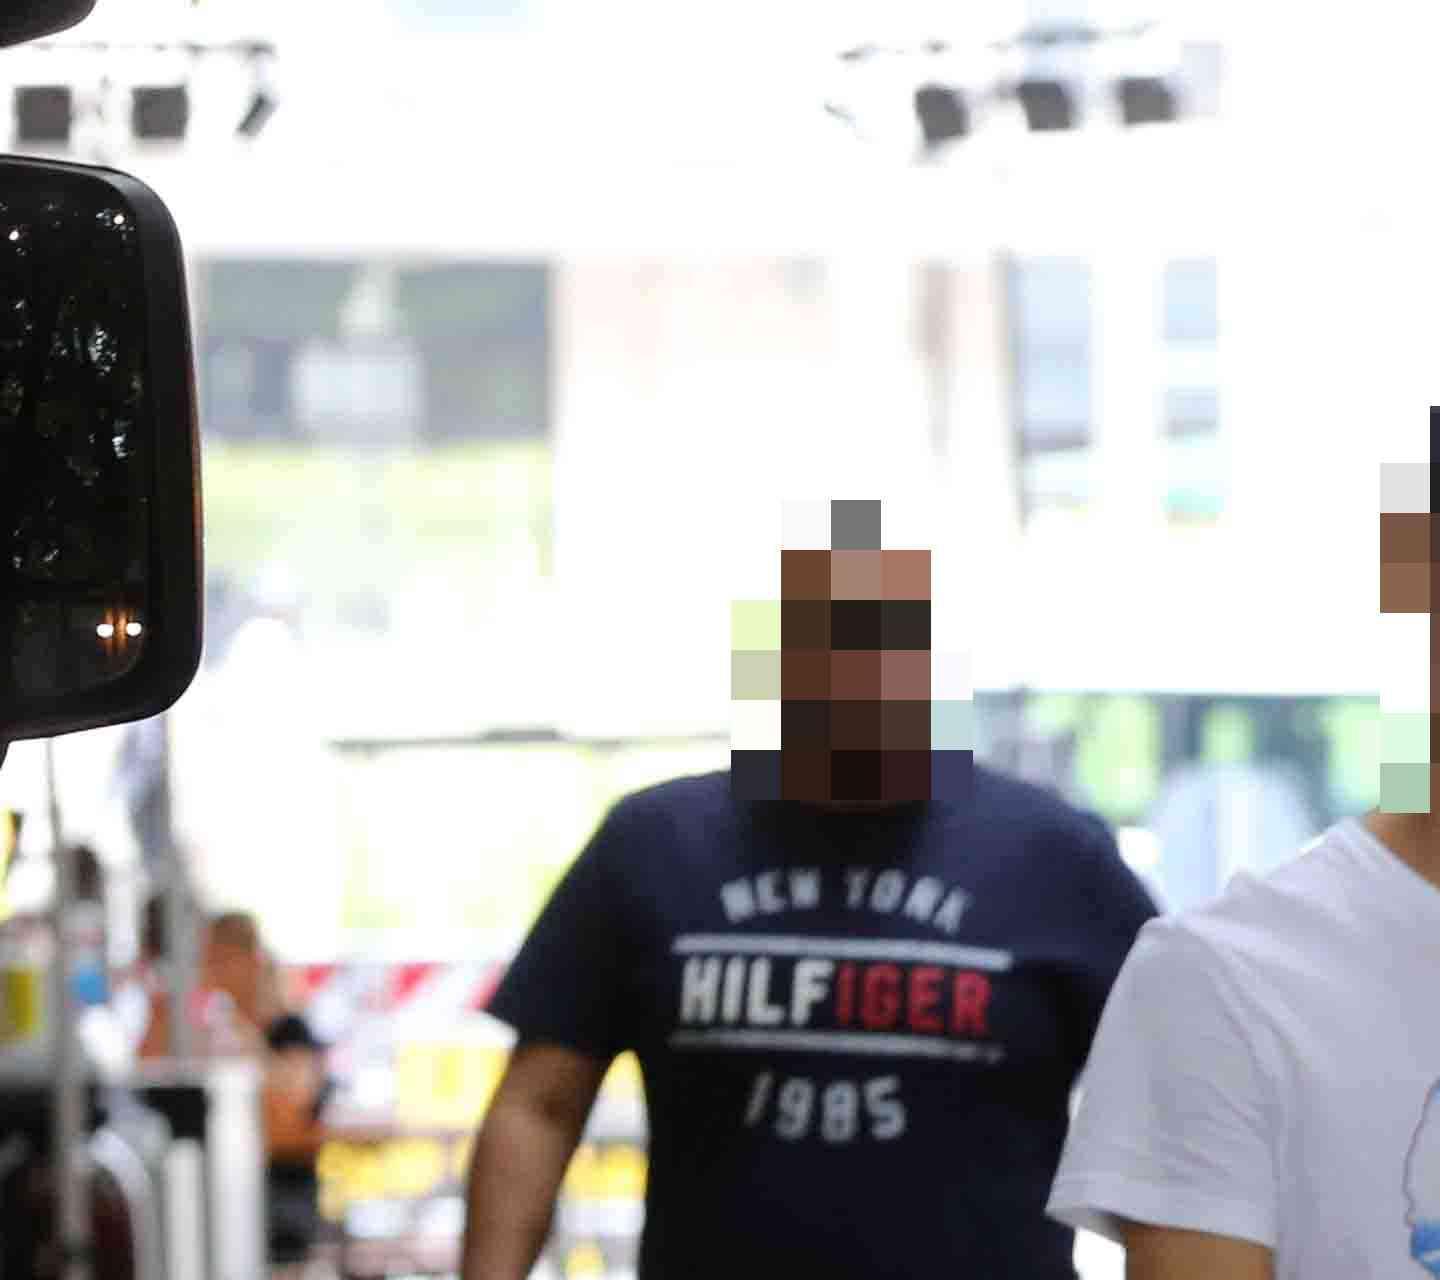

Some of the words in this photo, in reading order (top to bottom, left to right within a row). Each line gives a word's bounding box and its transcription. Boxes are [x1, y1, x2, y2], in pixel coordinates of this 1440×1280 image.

[719, 867, 824, 924] NEW
[844, 868, 973, 935] YORK
[680, 956, 992, 1035] HILFIGER
[743, 1069, 906, 1144] 1985
